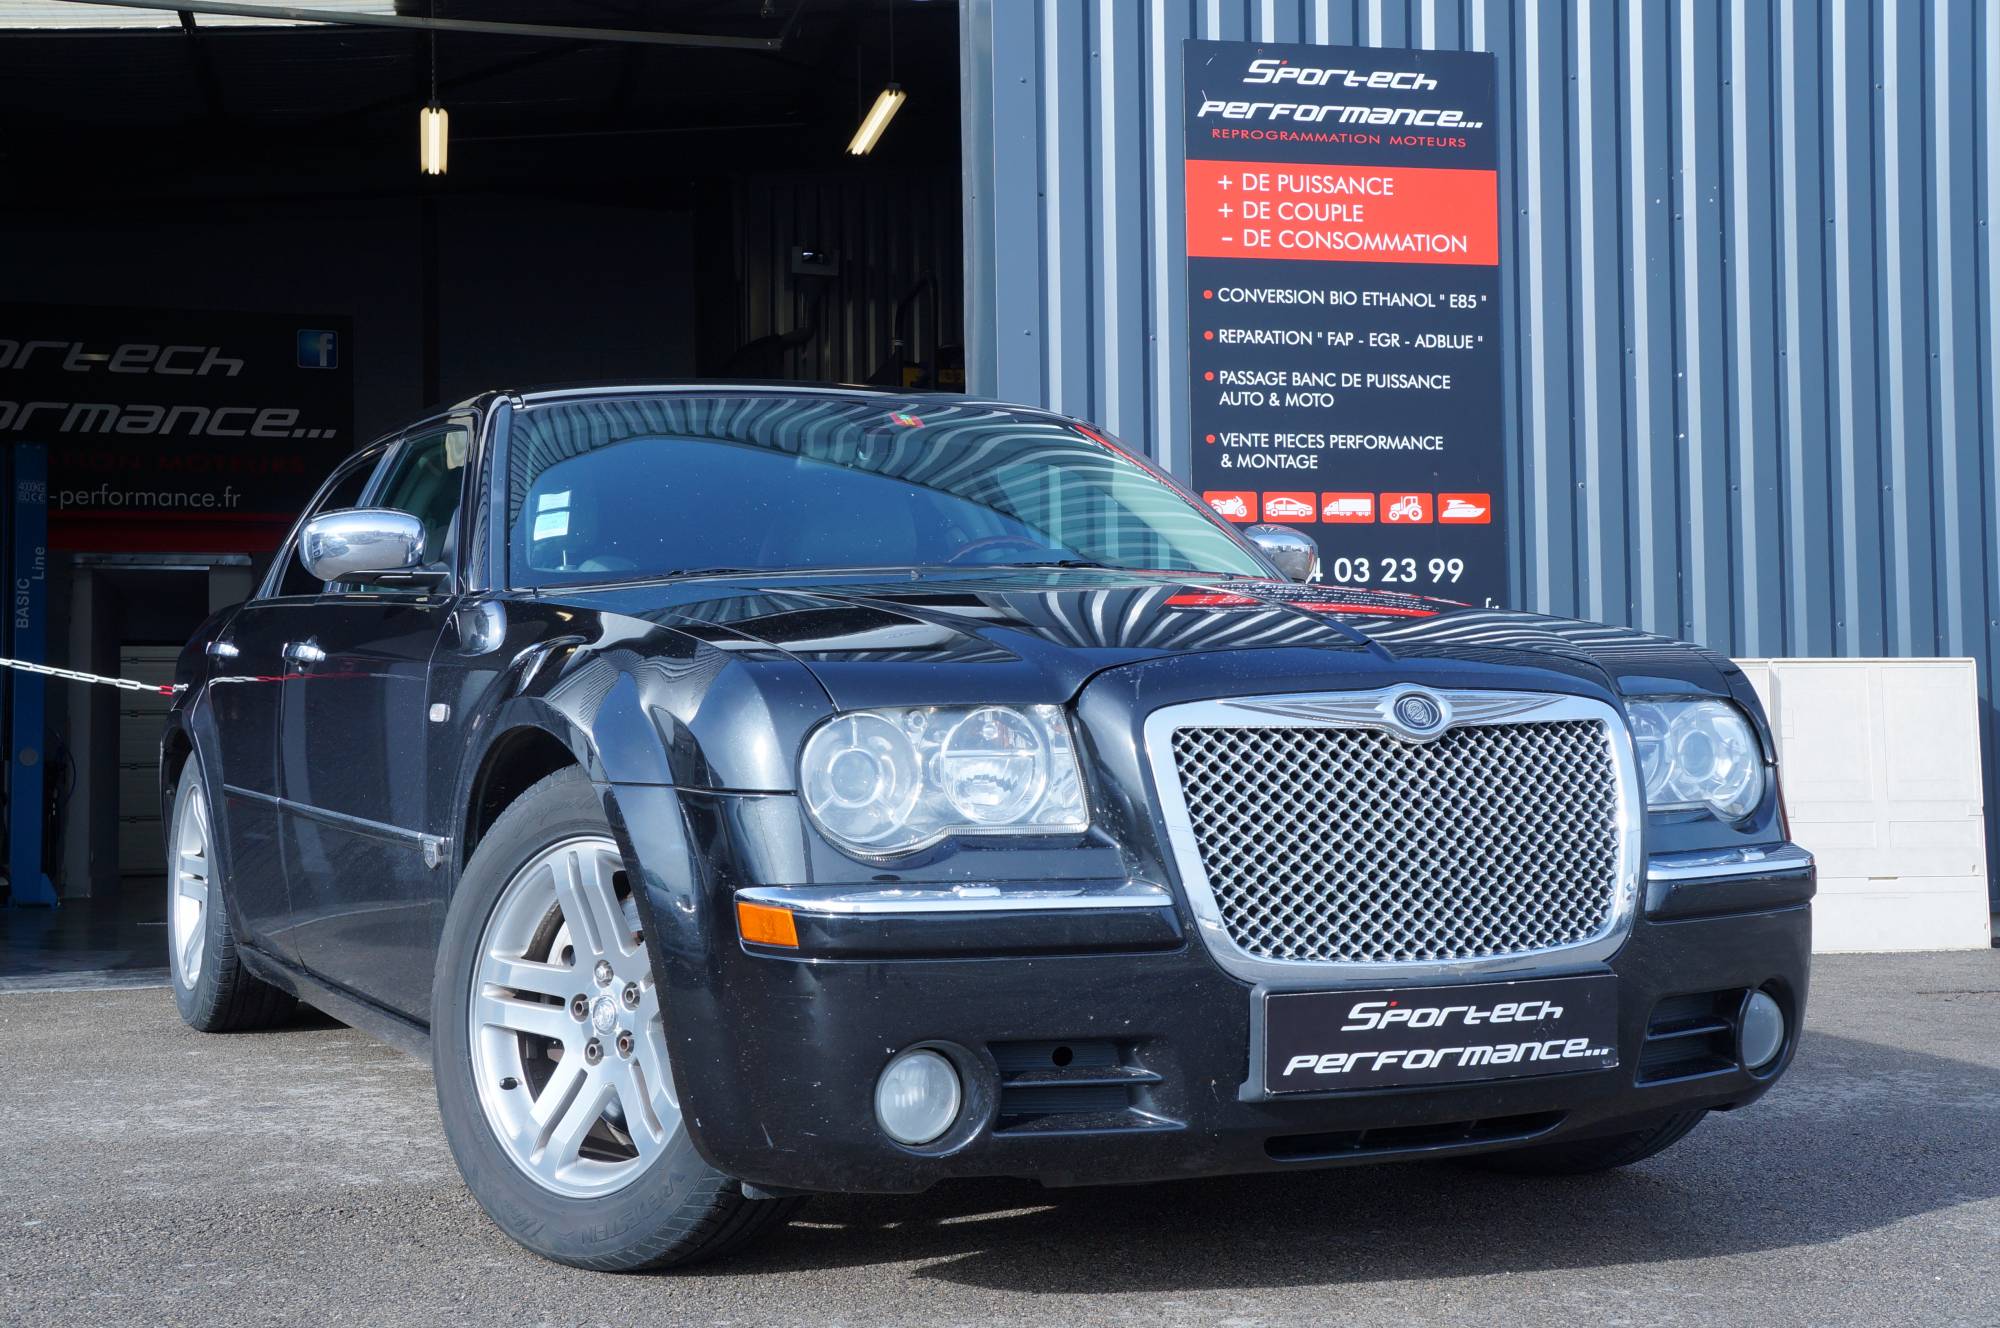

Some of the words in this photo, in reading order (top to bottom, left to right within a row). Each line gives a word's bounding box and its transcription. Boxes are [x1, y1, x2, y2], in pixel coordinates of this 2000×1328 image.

[1211, 128, 1380, 144] REPROGRAMMATION
[1389, 136, 1466, 148] MOTEURS
[1243, 173, 1269, 191] DE
[1278, 174, 1393, 195] PUISSANCE
[1243, 201, 1270, 219] DE
[1278, 202, 1363, 222] COUPLE
[1244, 229, 1270, 247] DE
[1279, 230, 1466, 252] CONSOMMATION
[1218, 288, 1324, 304] CONVERSION
[1330, 291, 1357, 305] BIO
[1363, 292, 1435, 307] ETHANOL
[1450, 294, 1476, 308] E85
[1220, 329, 1312, 345] REPARATION
[1328, 332, 1353, 345] FAP
[1370, 333, 1400, 347] EGR
[1415, 334, 1473, 348] ADBLUE
[1220, 371, 1286, 385] PASSAGE
[1293, 372, 1336, 387] BANC
[1342, 373, 1361, 387] DE
[1367, 374, 1450, 389] PUISSANCE
[1219, 392, 1264, 406] AUTO
[1269, 393, 1280, 406] &
[1286, 393, 1334, 407] MOTO
[1220, 433, 1268, 447] VENTE
[1275, 434, 1325, 448] PIECES
[1330, 435, 1443, 450] PERFORMANCE
[1221, 454, 1232, 467] &
[1237, 454, 1317, 468] MONTAGE
[32, 546, 45, 580] Line
[1335, 558, 1369, 582] 03
[1381, 558, 1416, 582] 23
[1429, 559, 1463, 583] 99
[16, 578, 30, 629] BASIC
